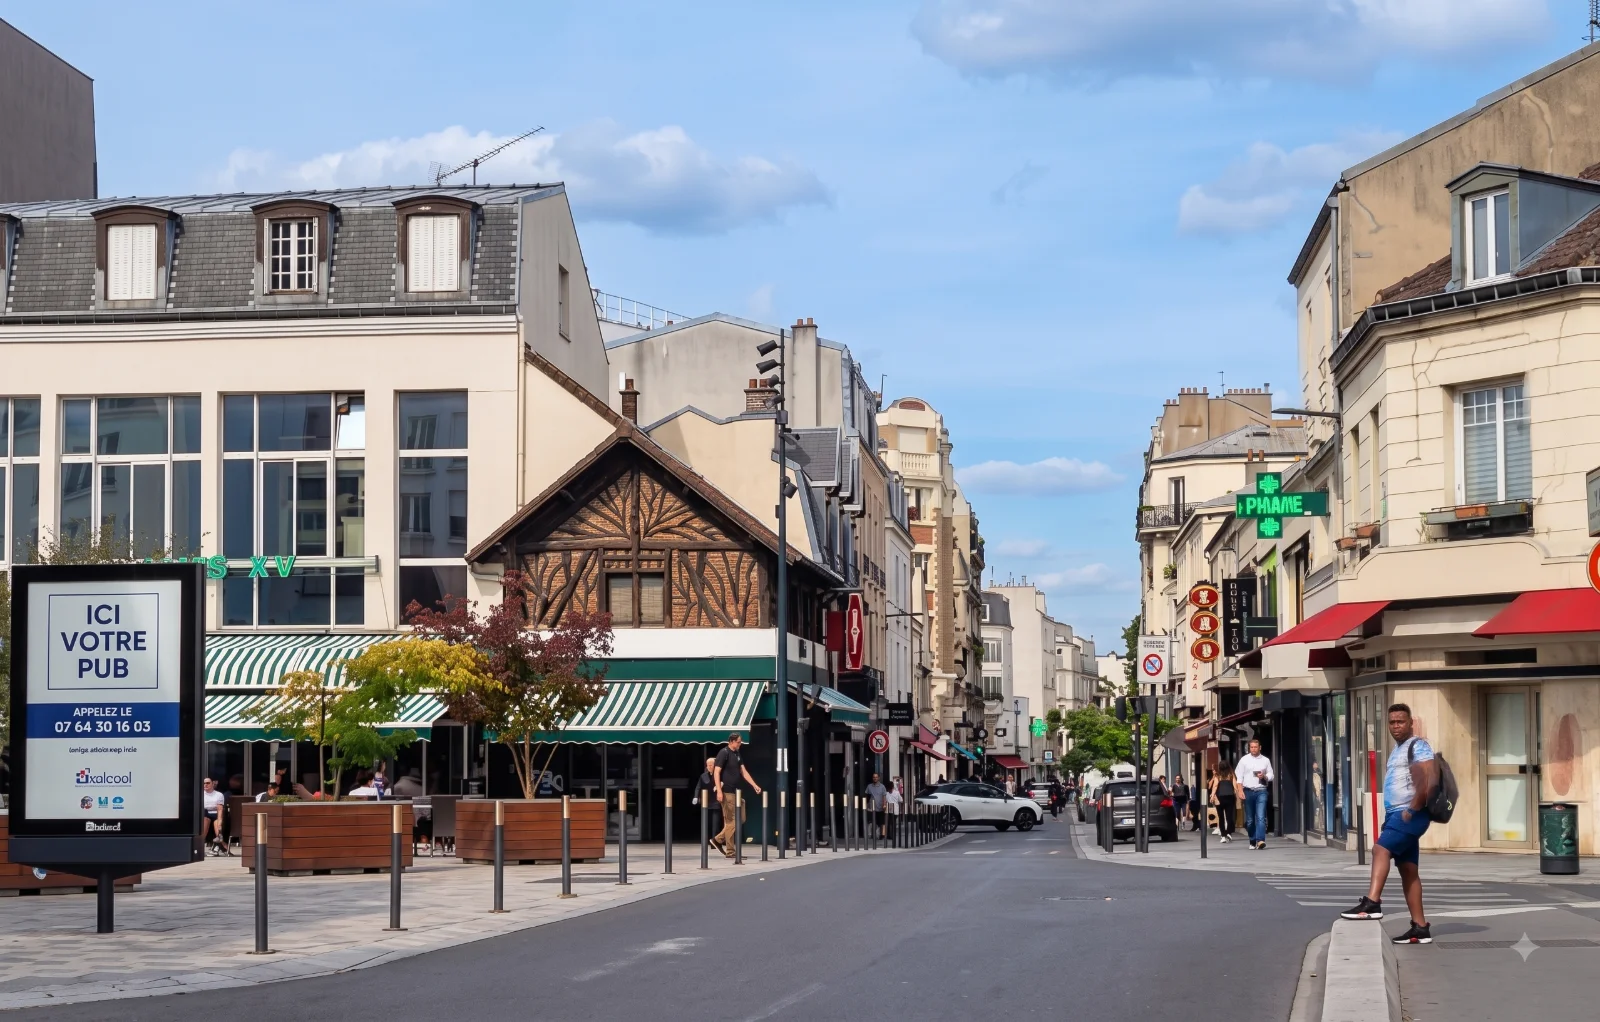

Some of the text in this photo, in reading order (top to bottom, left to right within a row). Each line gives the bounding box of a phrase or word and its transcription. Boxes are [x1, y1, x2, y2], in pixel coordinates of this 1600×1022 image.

[248, 555, 295, 578] XV
[86, 604, 120, 625] ICI
[60, 630, 147, 652] VOTRE
[78, 657, 129, 679] PUB
[73, 707, 132, 717] APPELEZ LE
[54, 720, 151, 733] 07 64 30 16 03
